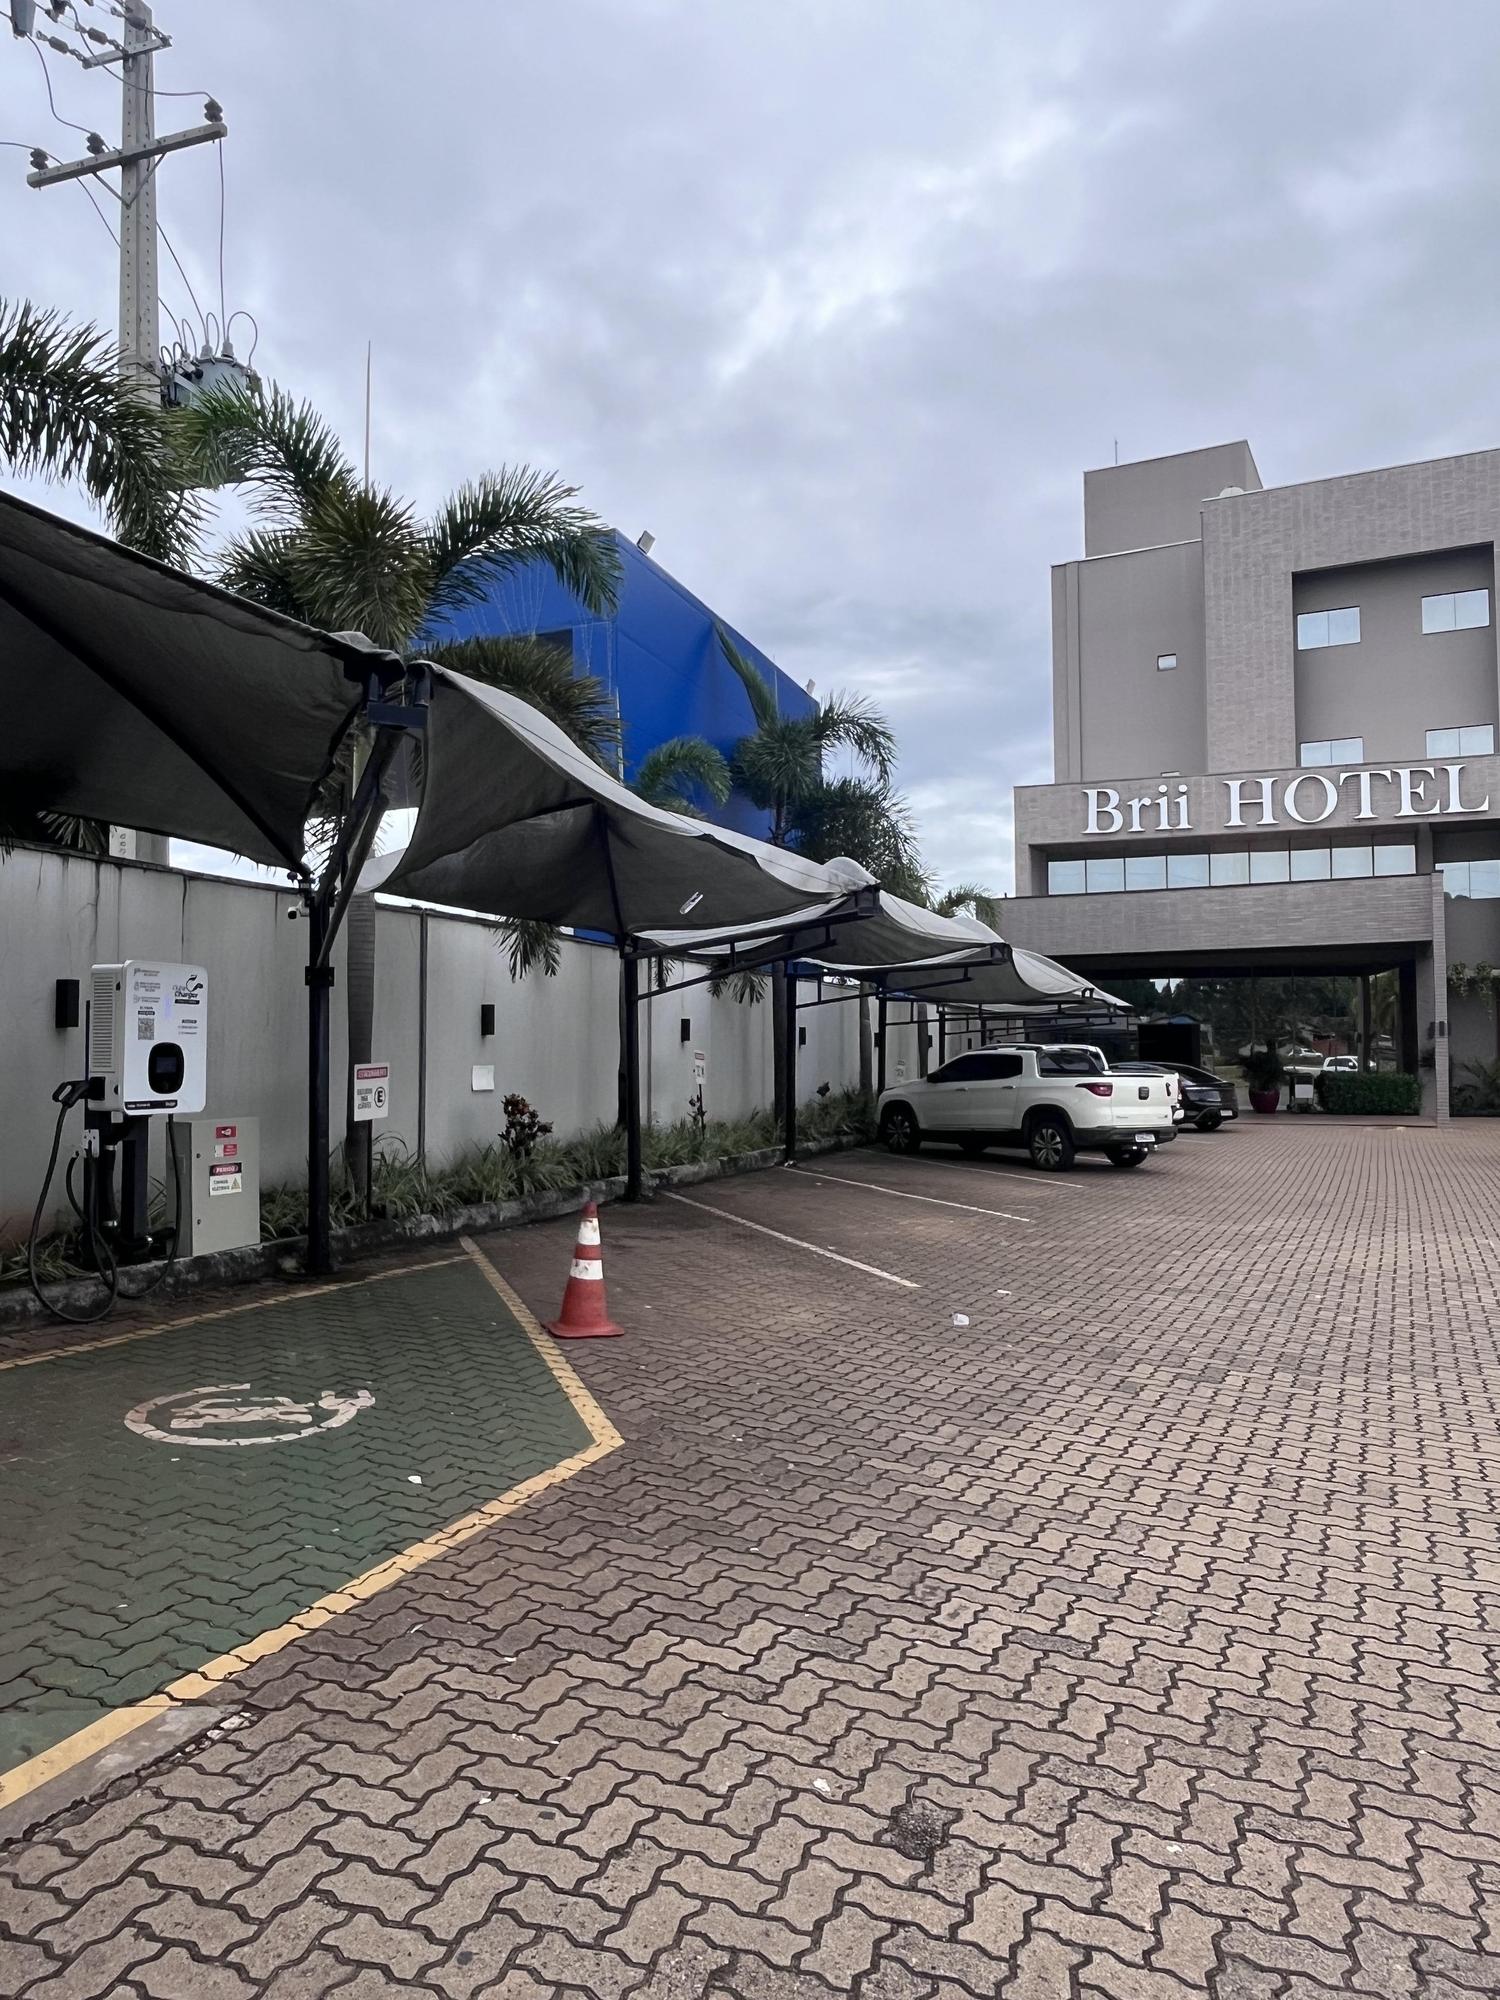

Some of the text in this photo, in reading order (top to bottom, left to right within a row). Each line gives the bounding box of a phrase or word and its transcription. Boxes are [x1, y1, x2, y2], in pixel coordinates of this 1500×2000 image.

[1081, 764, 1490, 835] Brii HOTEL
[377, 1090, 383, 1103] E
